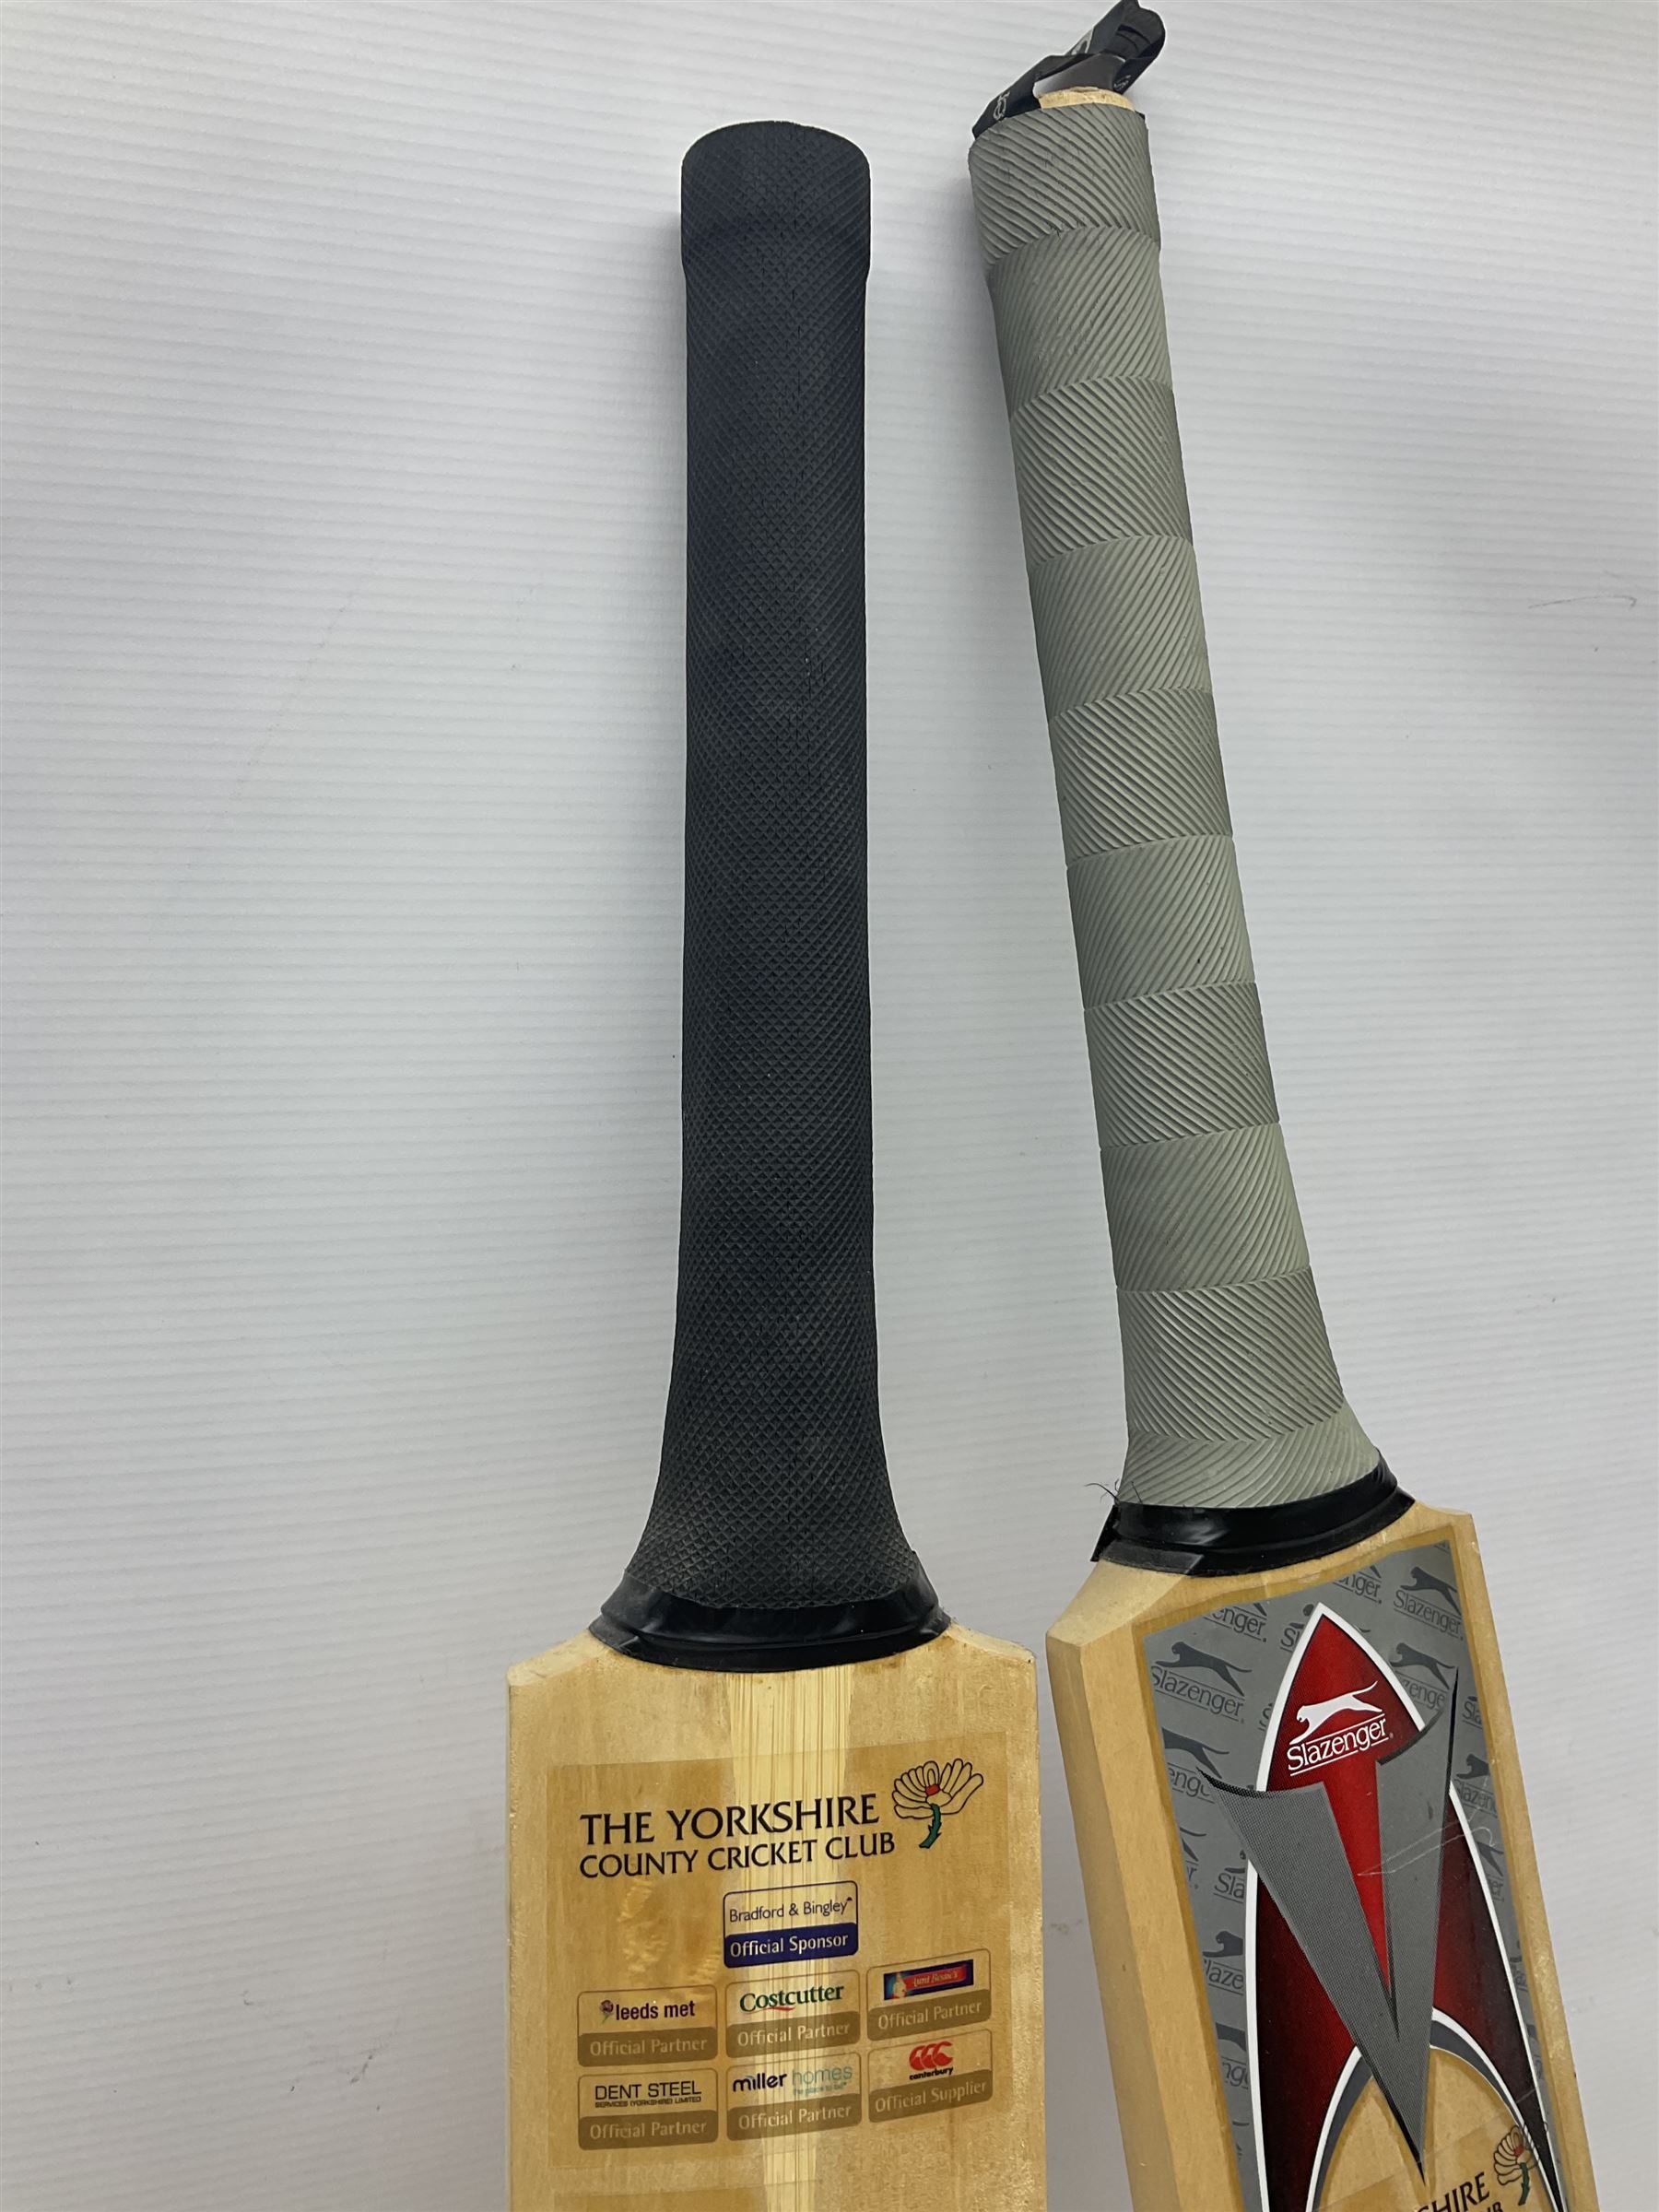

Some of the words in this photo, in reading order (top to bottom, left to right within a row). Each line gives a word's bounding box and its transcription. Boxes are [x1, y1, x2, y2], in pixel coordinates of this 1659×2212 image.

[1393, 1589, 1461, 1634] Slazenger
[1151, 1665, 1244, 1716] Slazenger
[1287, 1718, 1386, 1771] Slazenger
[580, 1811, 655, 1845] THE
[666, 1793, 880, 1841] YORKSHIRE
[580, 1849, 699, 1878] COUNTY
[707, 1839, 818, 1871] CRICKET
[825, 1831, 896, 1860] CLUB
[729, 1903, 785, 1922] Bradford
[788, 1902, 799, 1917] &
[803, 1899, 848, 1917] Bingley
[730, 1936, 784, 1958] Official
[789, 1934, 848, 1955] Sponsor
[616, 2003, 658, 2020] leeds
[664, 2000, 696, 2018] met
[739, 1985, 844, 2013] Costcutter
[878, 2008, 929, 2029] Official
[934, 2001, 982, 2021] Partner
[590, 2040, 645, 2056] Official
[652, 2038, 708, 2053] Partner
[737, 2027, 792, 2047] Official
[797, 2022, 850, 2041] Partner
[733, 2073, 788, 2092] miller
[792, 2065, 853, 2086] homes
[909, 2065, 954, 2080] canterbury
[594, 2084, 642, 2100] DENT
[647, 2080, 702, 2098] STEEL
[876, 2094, 927, 2113] Official
[931, 2080, 987, 2103] Supplier
[590, 2123, 645, 2140] Official
[652, 2121, 708, 2136] Partner
[738, 2110, 793, 2130] Official
[798, 2105, 852, 2124] Partner
